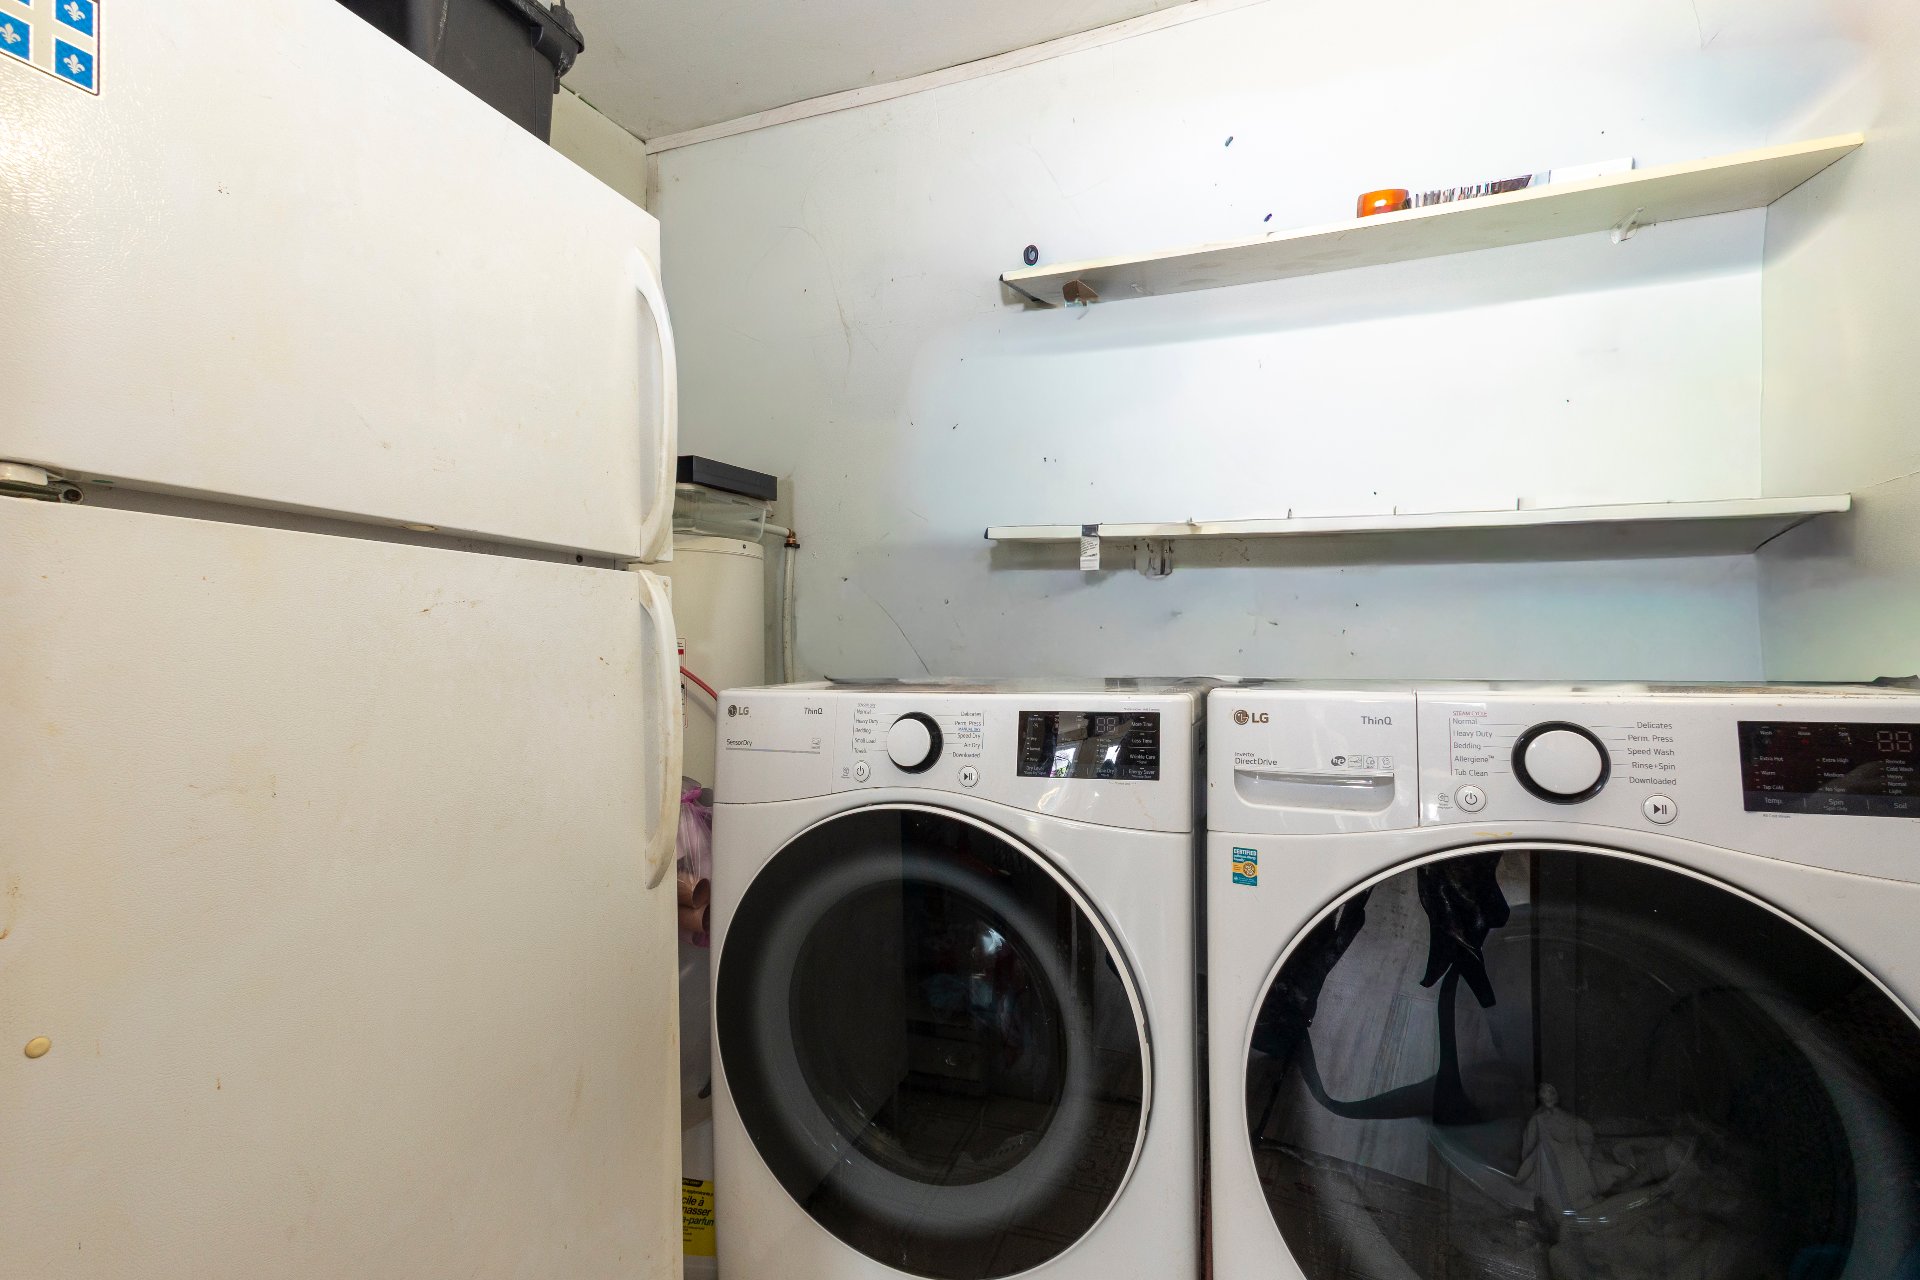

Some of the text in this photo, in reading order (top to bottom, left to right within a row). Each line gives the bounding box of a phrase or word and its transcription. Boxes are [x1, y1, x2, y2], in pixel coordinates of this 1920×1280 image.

[738, 706, 749, 716] LG
[804, 707, 823, 716] ThinQ
[1252, 712, 1269, 723] LG
[1360, 715, 1393, 726] ThinQ
[1452, 717, 1478, 725] Normal
[1636, 721, 1673, 730] Delicates
[1453, 730, 1493, 739] Heavy Duty
[1627, 734, 1674, 743] Perm. Press
[726, 738, 753, 747] SensorDry
[1453, 742, 1482, 751] Bedding
[1627, 747, 1675, 757] Speed Wash
[1468, 769, 1489, 777] Clean
[1628, 776, 1677, 785] Downloaded
[1828, 798, 1844, 807] Spin
[1893, 801, 1908, 809] Soil
[697, 1196, 704, 1207] à
